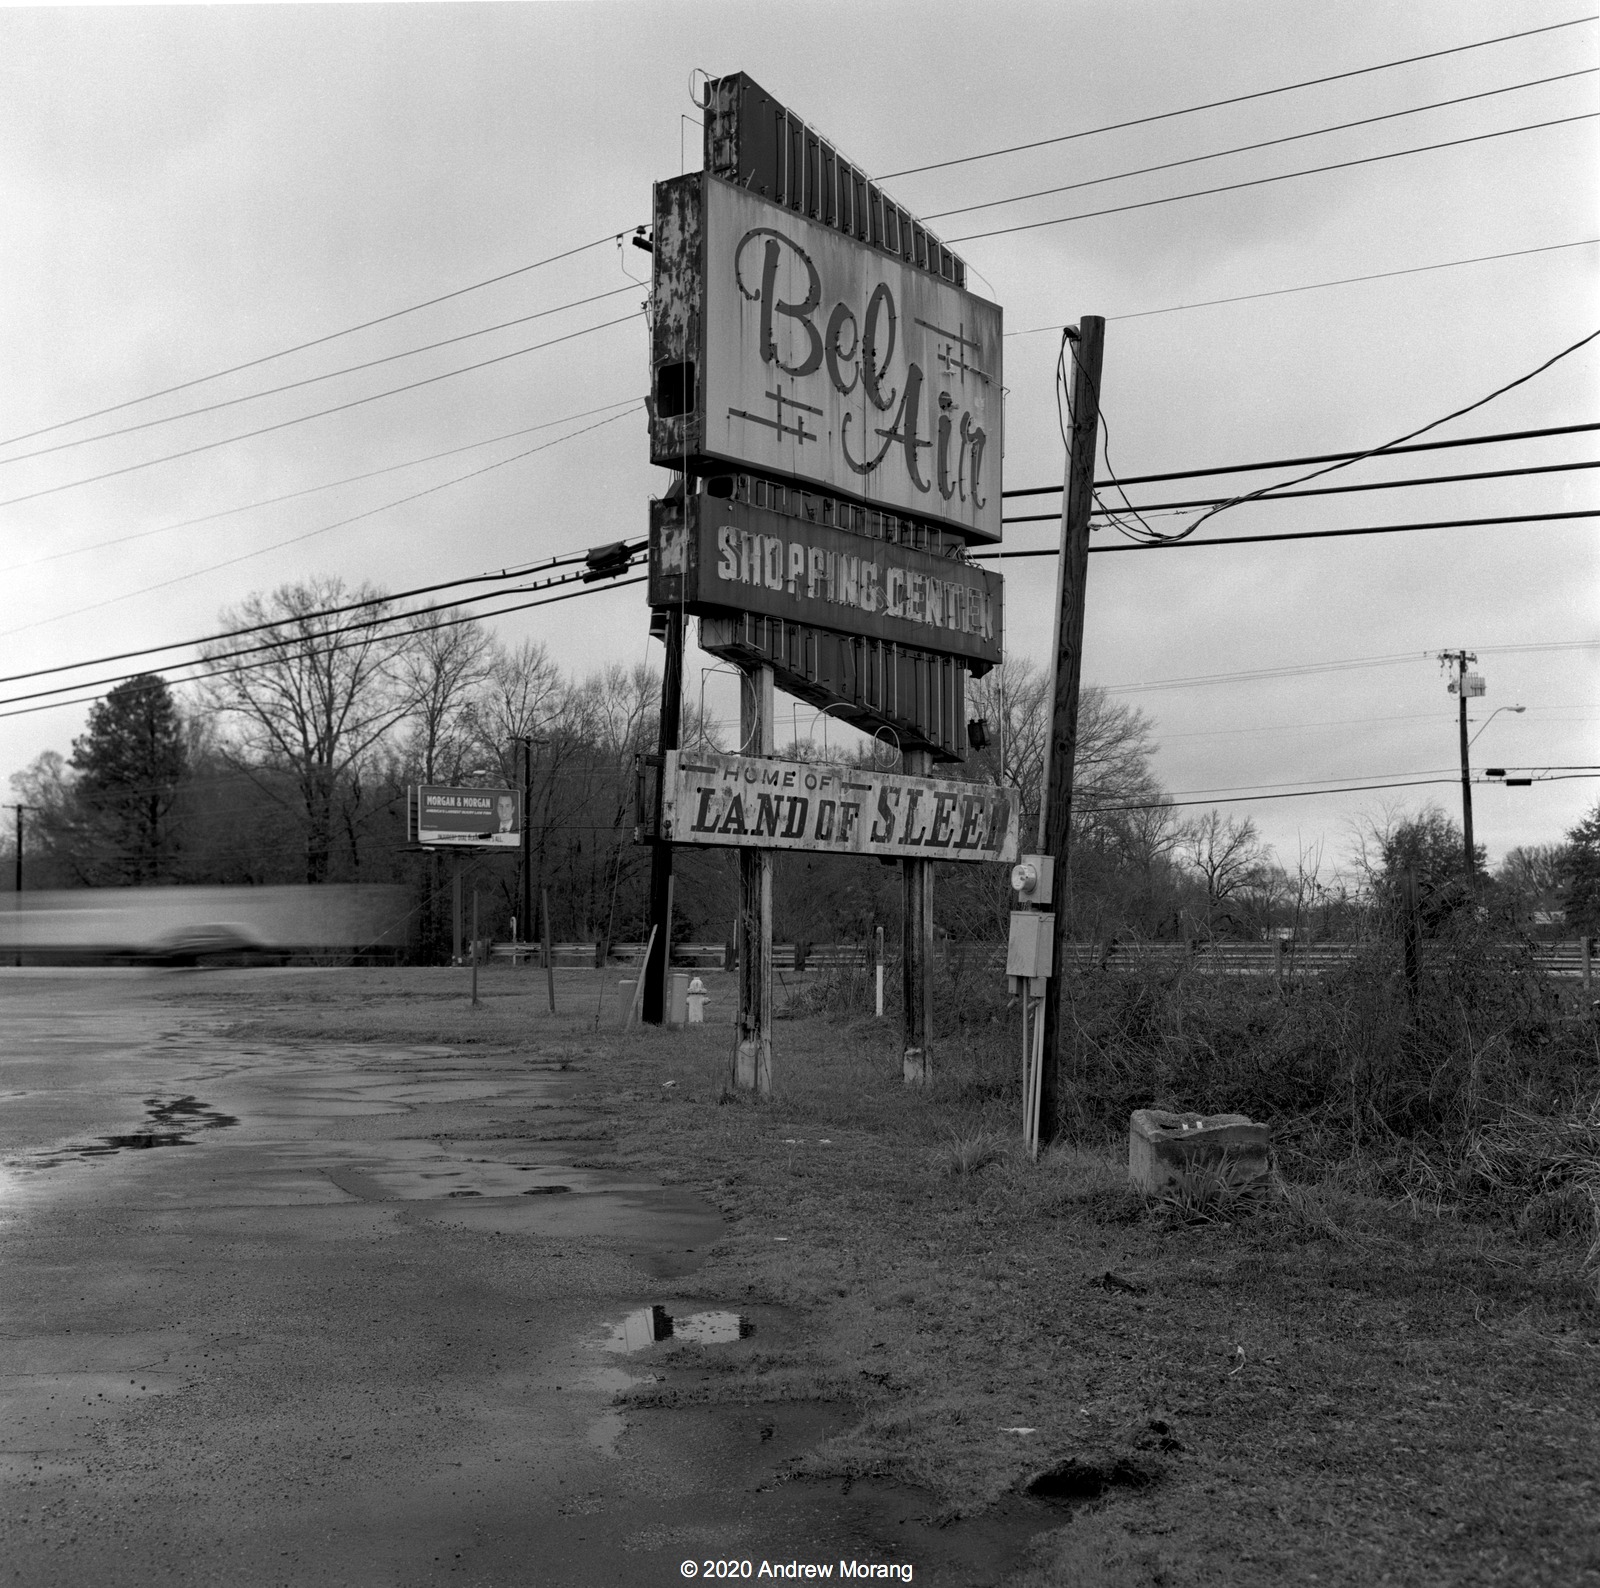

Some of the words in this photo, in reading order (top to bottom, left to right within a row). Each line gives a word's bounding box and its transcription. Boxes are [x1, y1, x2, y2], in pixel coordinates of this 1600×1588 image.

[734, 226, 897, 412] Bel
[841, 362, 987, 510] Air
[717, 525, 879, 613] SHOPPING
[426, 795, 455, 807] MORGAN
[456, 797, 462, 807] &
[463, 797, 491, 809] MORGAN
[723, 765, 795, 788] HOME
[804, 772, 833, 791] OF
[690, 787, 808, 840] LAND
[814, 799, 861, 843] OF
